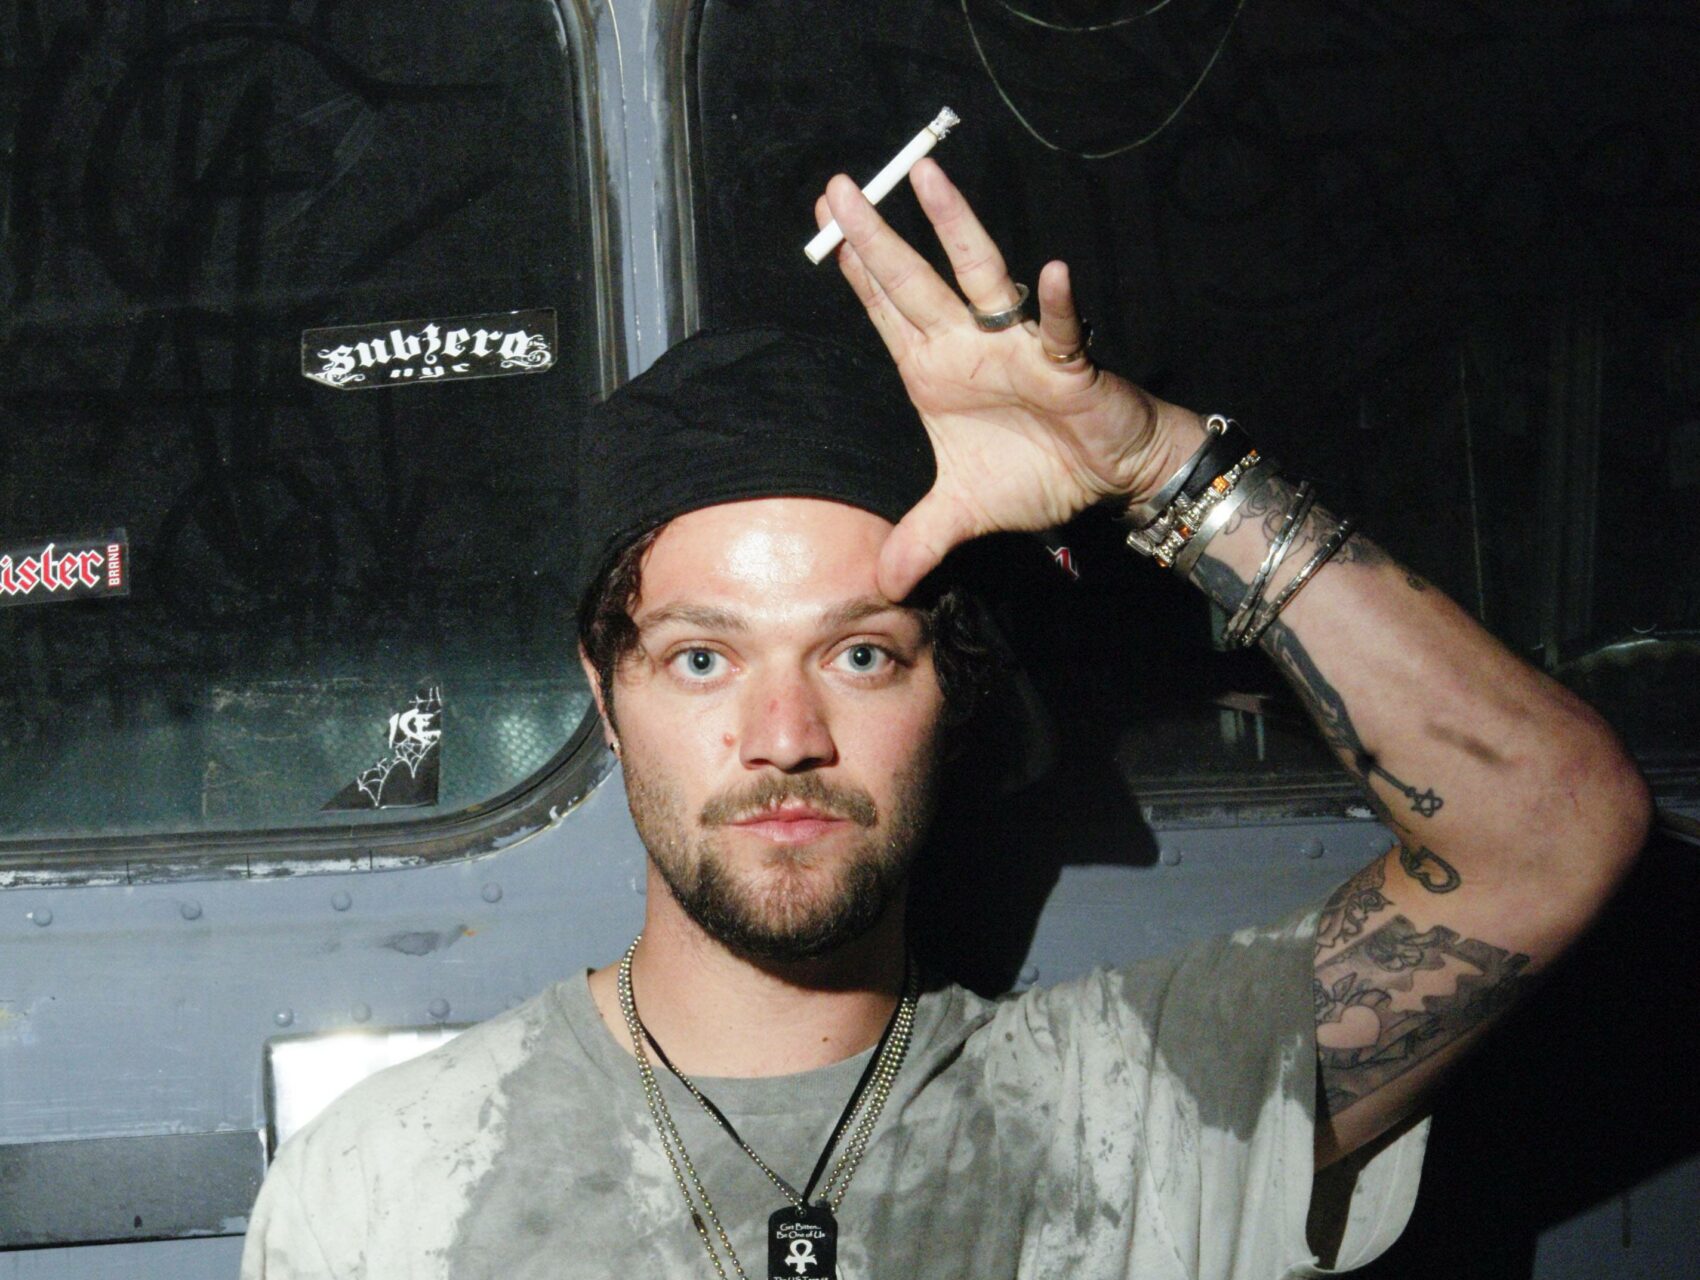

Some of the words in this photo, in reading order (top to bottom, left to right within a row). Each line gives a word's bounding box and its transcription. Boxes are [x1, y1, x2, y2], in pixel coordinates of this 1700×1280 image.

[0, 543, 104, 595] ister
[107, 543, 120, 586] BRAND
[776, 1231, 787, 1239] Be
[788, 1230, 803, 1239] One
[780, 1223, 794, 1231] Get
